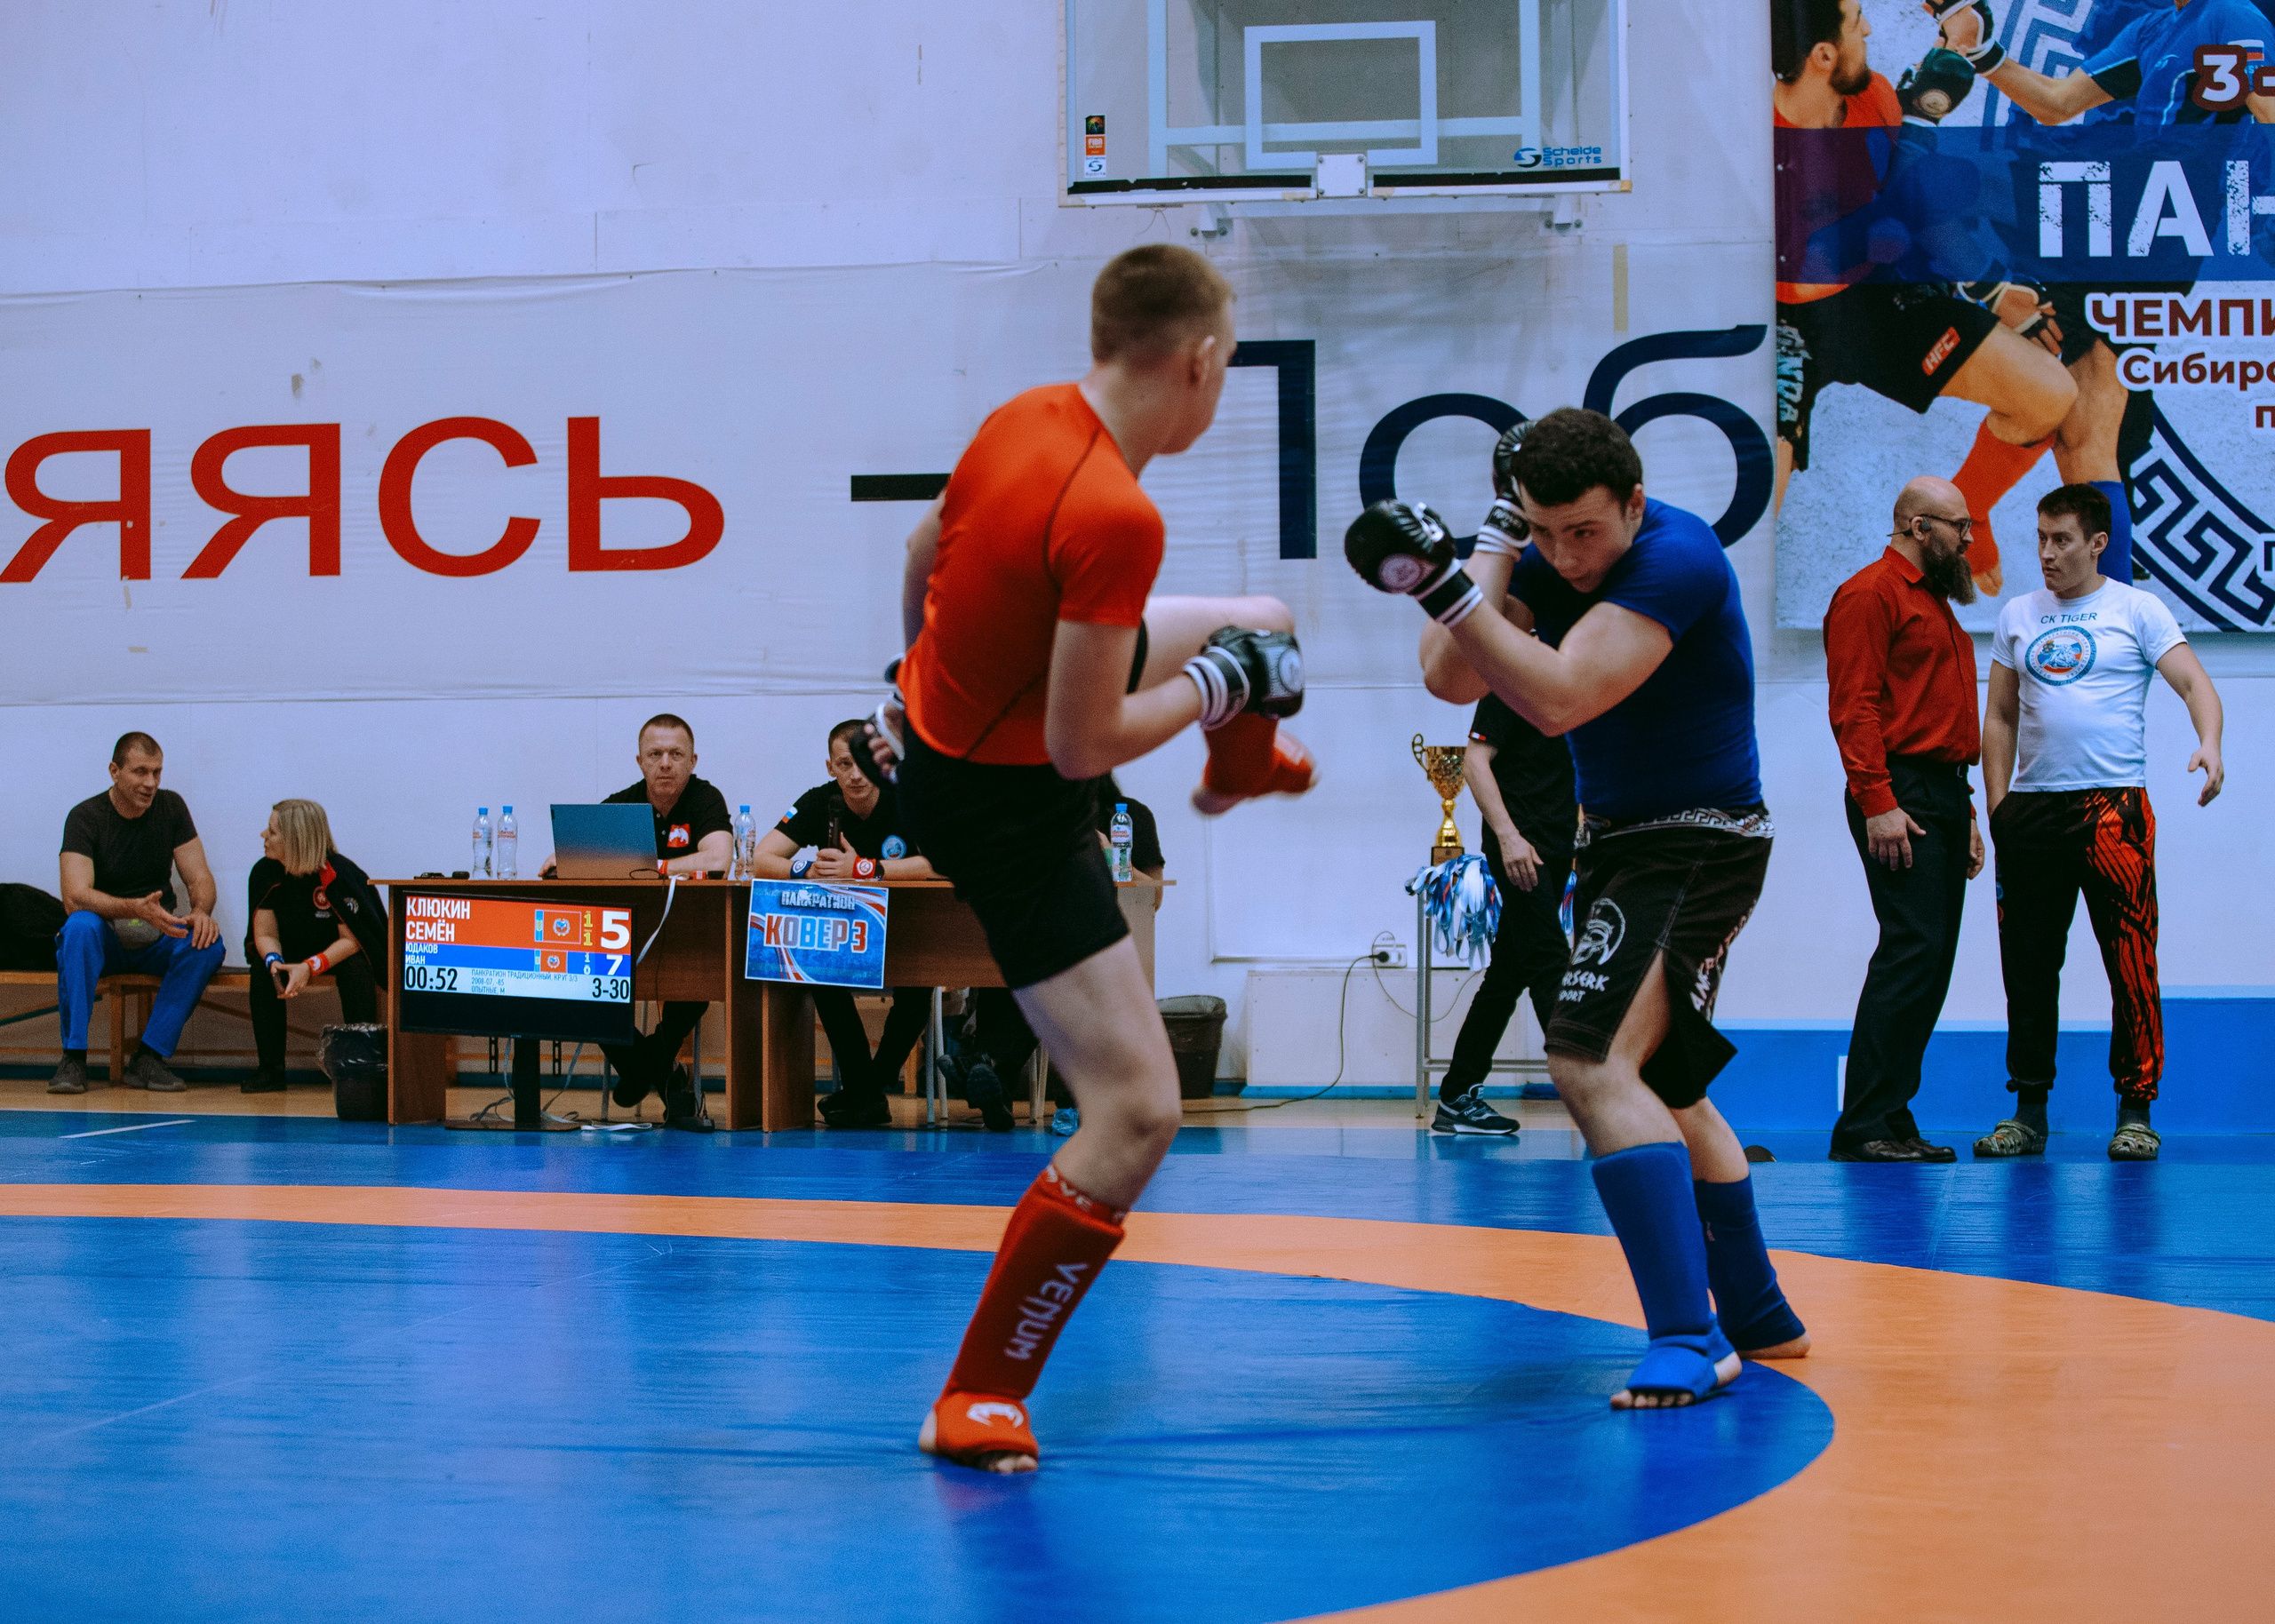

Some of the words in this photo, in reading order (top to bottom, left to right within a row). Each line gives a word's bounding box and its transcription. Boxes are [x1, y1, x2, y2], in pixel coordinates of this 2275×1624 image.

[1543, 155, 1601, 167] Sports
[2061, 612, 2097, 623] TIGER
[406, 897, 471, 919] КЛЮКИН
[406, 919, 455, 942] СЕМЁН
[601, 910, 630, 950] 5
[764, 913, 850, 951] КОВЕР
[850, 919, 868, 953] 3
[405, 943, 438, 954] ЮДАКОВ
[405, 954, 426, 965] ИВАН
[606, 954, 623, 975] 7
[406, 966, 458, 991] 00:52
[472, 969, 507, 978] ПАНКРАТИОН
[592, 977, 629, 999] 3-30
